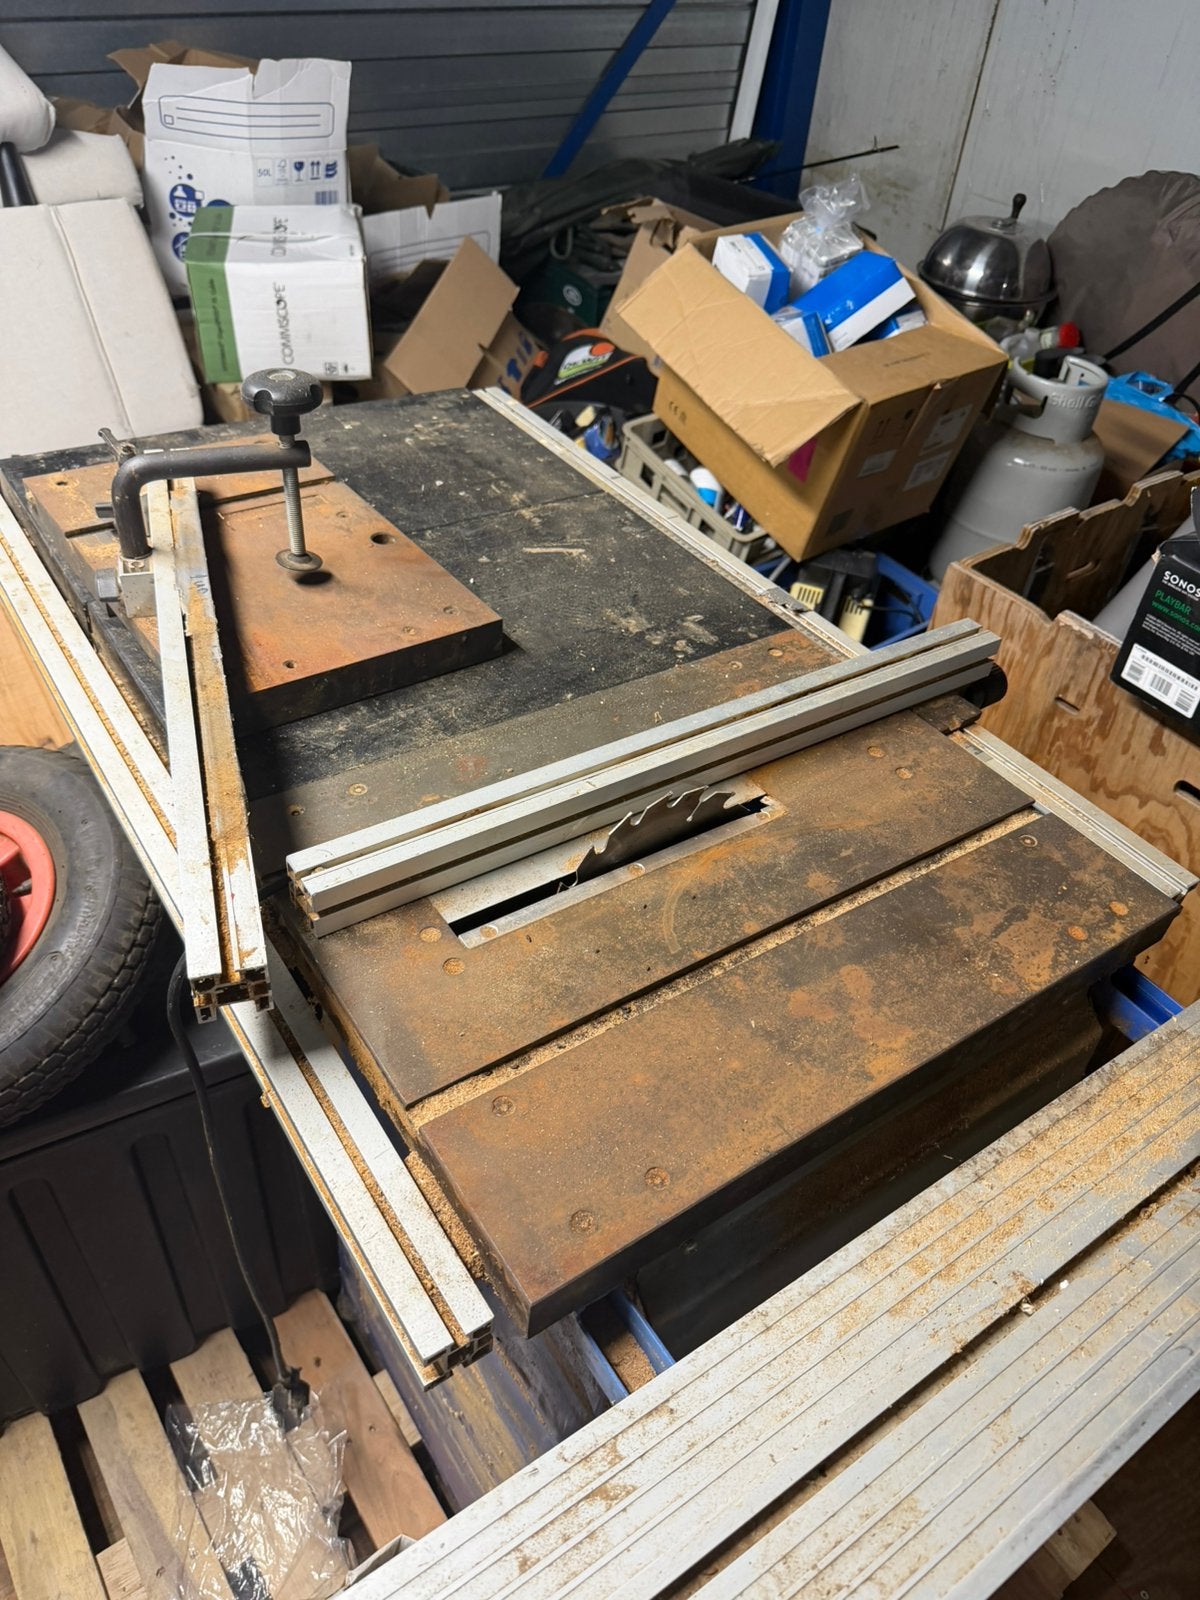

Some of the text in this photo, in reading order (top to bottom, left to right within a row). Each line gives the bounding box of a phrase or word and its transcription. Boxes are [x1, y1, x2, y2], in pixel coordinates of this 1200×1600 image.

[273, 283, 295, 366] COMMSCOPE
[1051, 392, 1085, 409] Shell
[1163, 570, 1200, 598] SONOS
[1154, 588, 1193, 616] PLAYBAR
